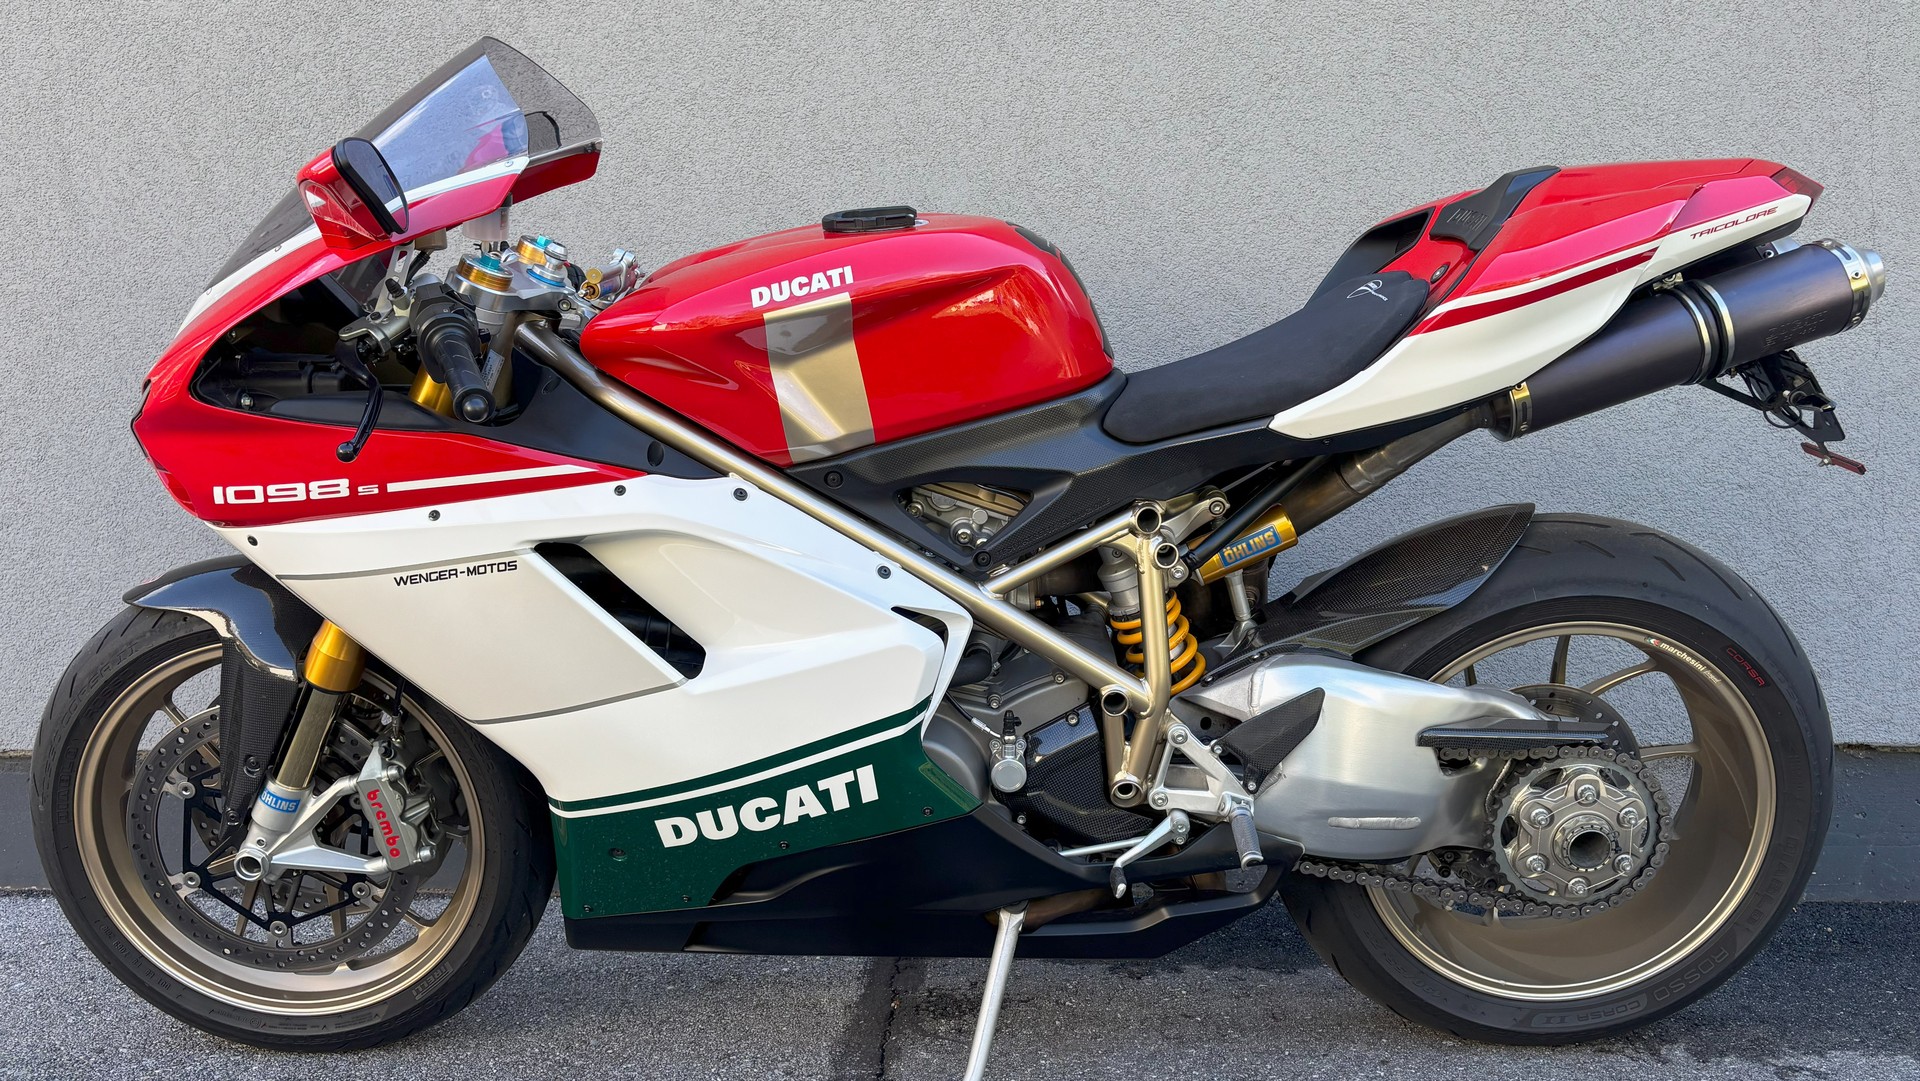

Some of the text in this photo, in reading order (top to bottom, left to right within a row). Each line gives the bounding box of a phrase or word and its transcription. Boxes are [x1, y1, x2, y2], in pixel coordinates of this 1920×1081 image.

[1690, 206, 1779, 240] TRICOLORE
[750, 265, 854, 308] DUCATI
[213, 478, 350, 504] 1098
[1223, 529, 1276, 563] ÖHLINS
[394, 560, 518, 587] WENGER-MOTOS
[1659, 641, 1707, 672] marchesini
[1726, 646, 1767, 687] CORSA
[366, 788, 401, 858] brembo
[654, 763, 879, 848] DUCATI
[412, 960, 455, 1001] PIRELLI
[1653, 945, 1731, 1002] ROSSO
[1576, 999, 1642, 1023] CORSA
